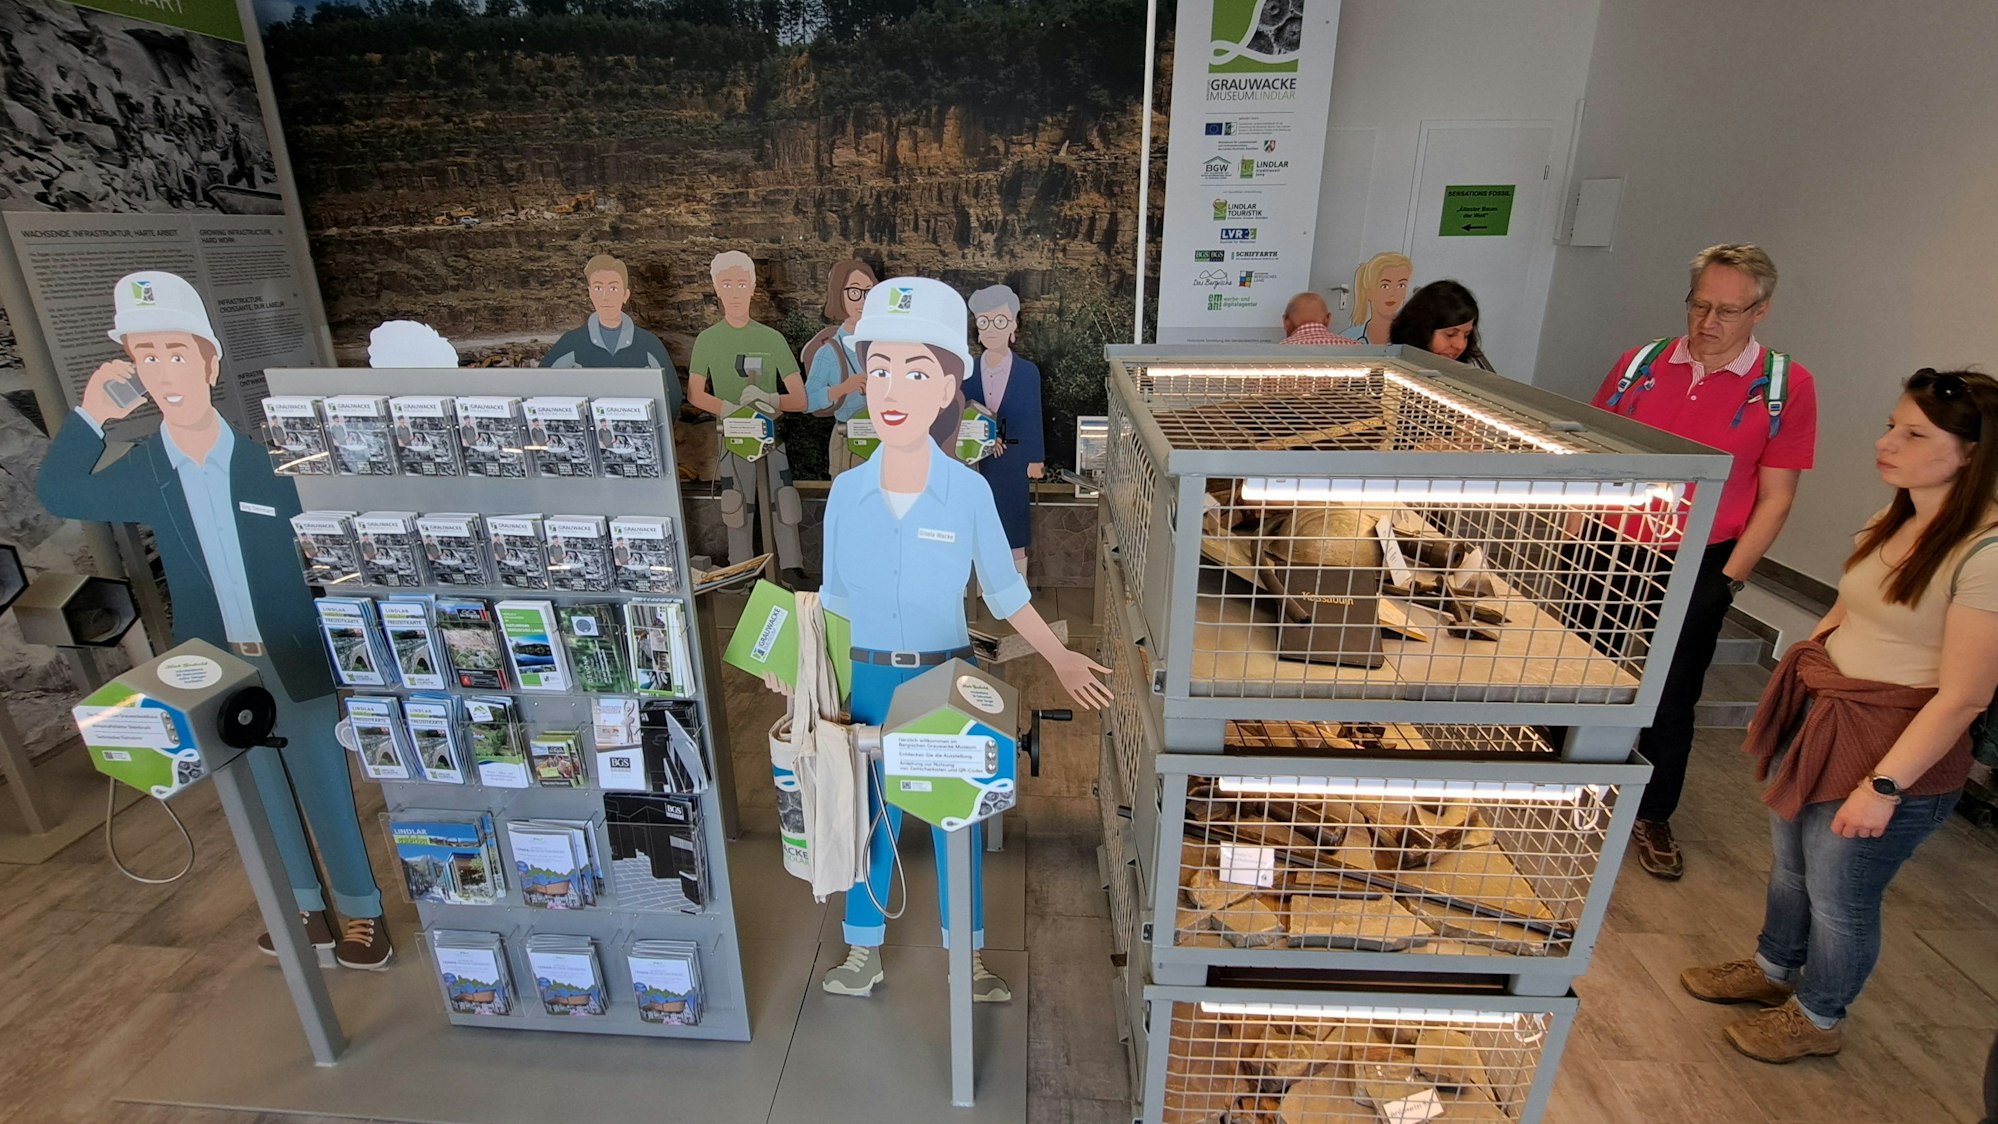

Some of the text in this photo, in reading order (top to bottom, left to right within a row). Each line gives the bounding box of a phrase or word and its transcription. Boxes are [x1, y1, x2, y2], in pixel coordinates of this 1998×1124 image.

[1210, 78, 1296, 90] GRAUWACKE
[22, 230, 72, 238] WACHSENDE
[1222, 230, 1243, 239] LVR
[759, 608, 780, 646] GRAUWACKE
[611, 758, 630, 767] BGS
[667, 804, 682, 814] BGS
